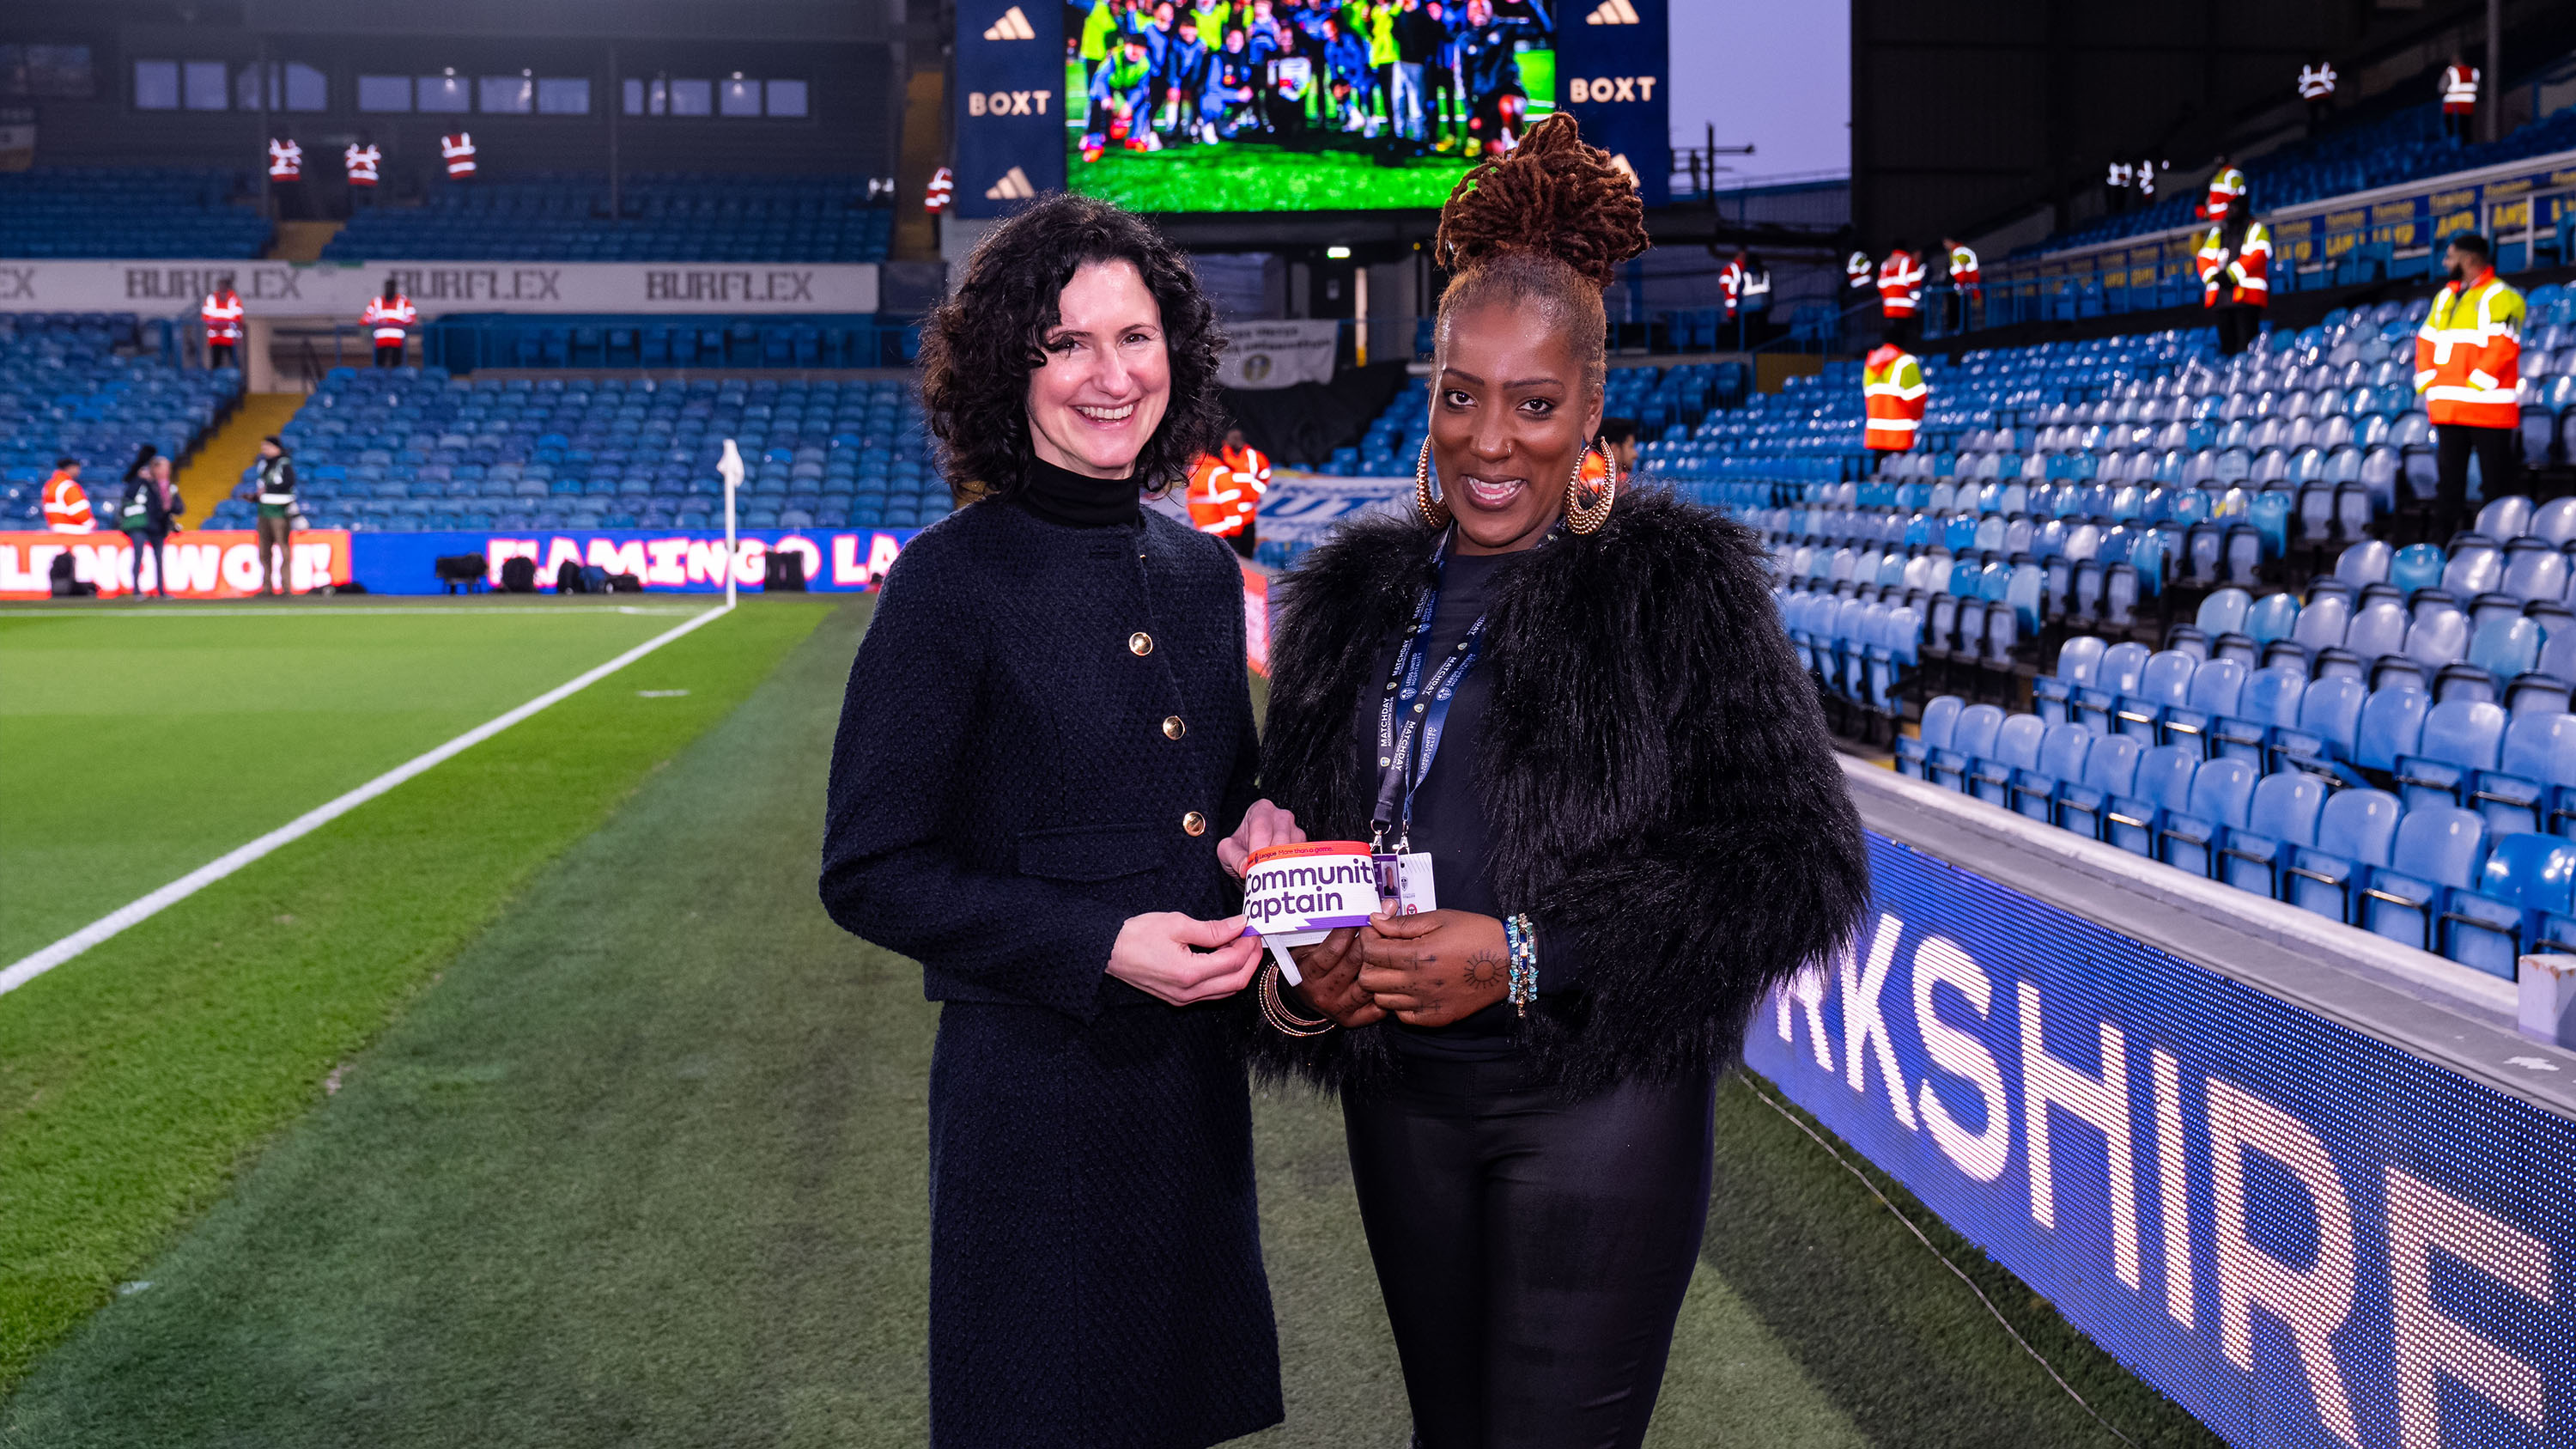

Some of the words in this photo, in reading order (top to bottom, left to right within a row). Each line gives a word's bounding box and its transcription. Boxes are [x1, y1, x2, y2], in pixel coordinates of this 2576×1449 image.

[969, 90, 1052, 117] BOXT
[1570, 76, 1657, 103] BOXT
[647, 271, 813, 301] BURFLEX
[1392, 639, 1410, 677] MATCHDAY
[1425, 656, 1457, 696] MATCHDAY
[1380, 697, 1390, 747] MATCHDAY
[1395, 720, 1416, 771] MATCHDAY
[1259, 851, 1277, 860] League
[1246, 858, 1377, 898] Communit
